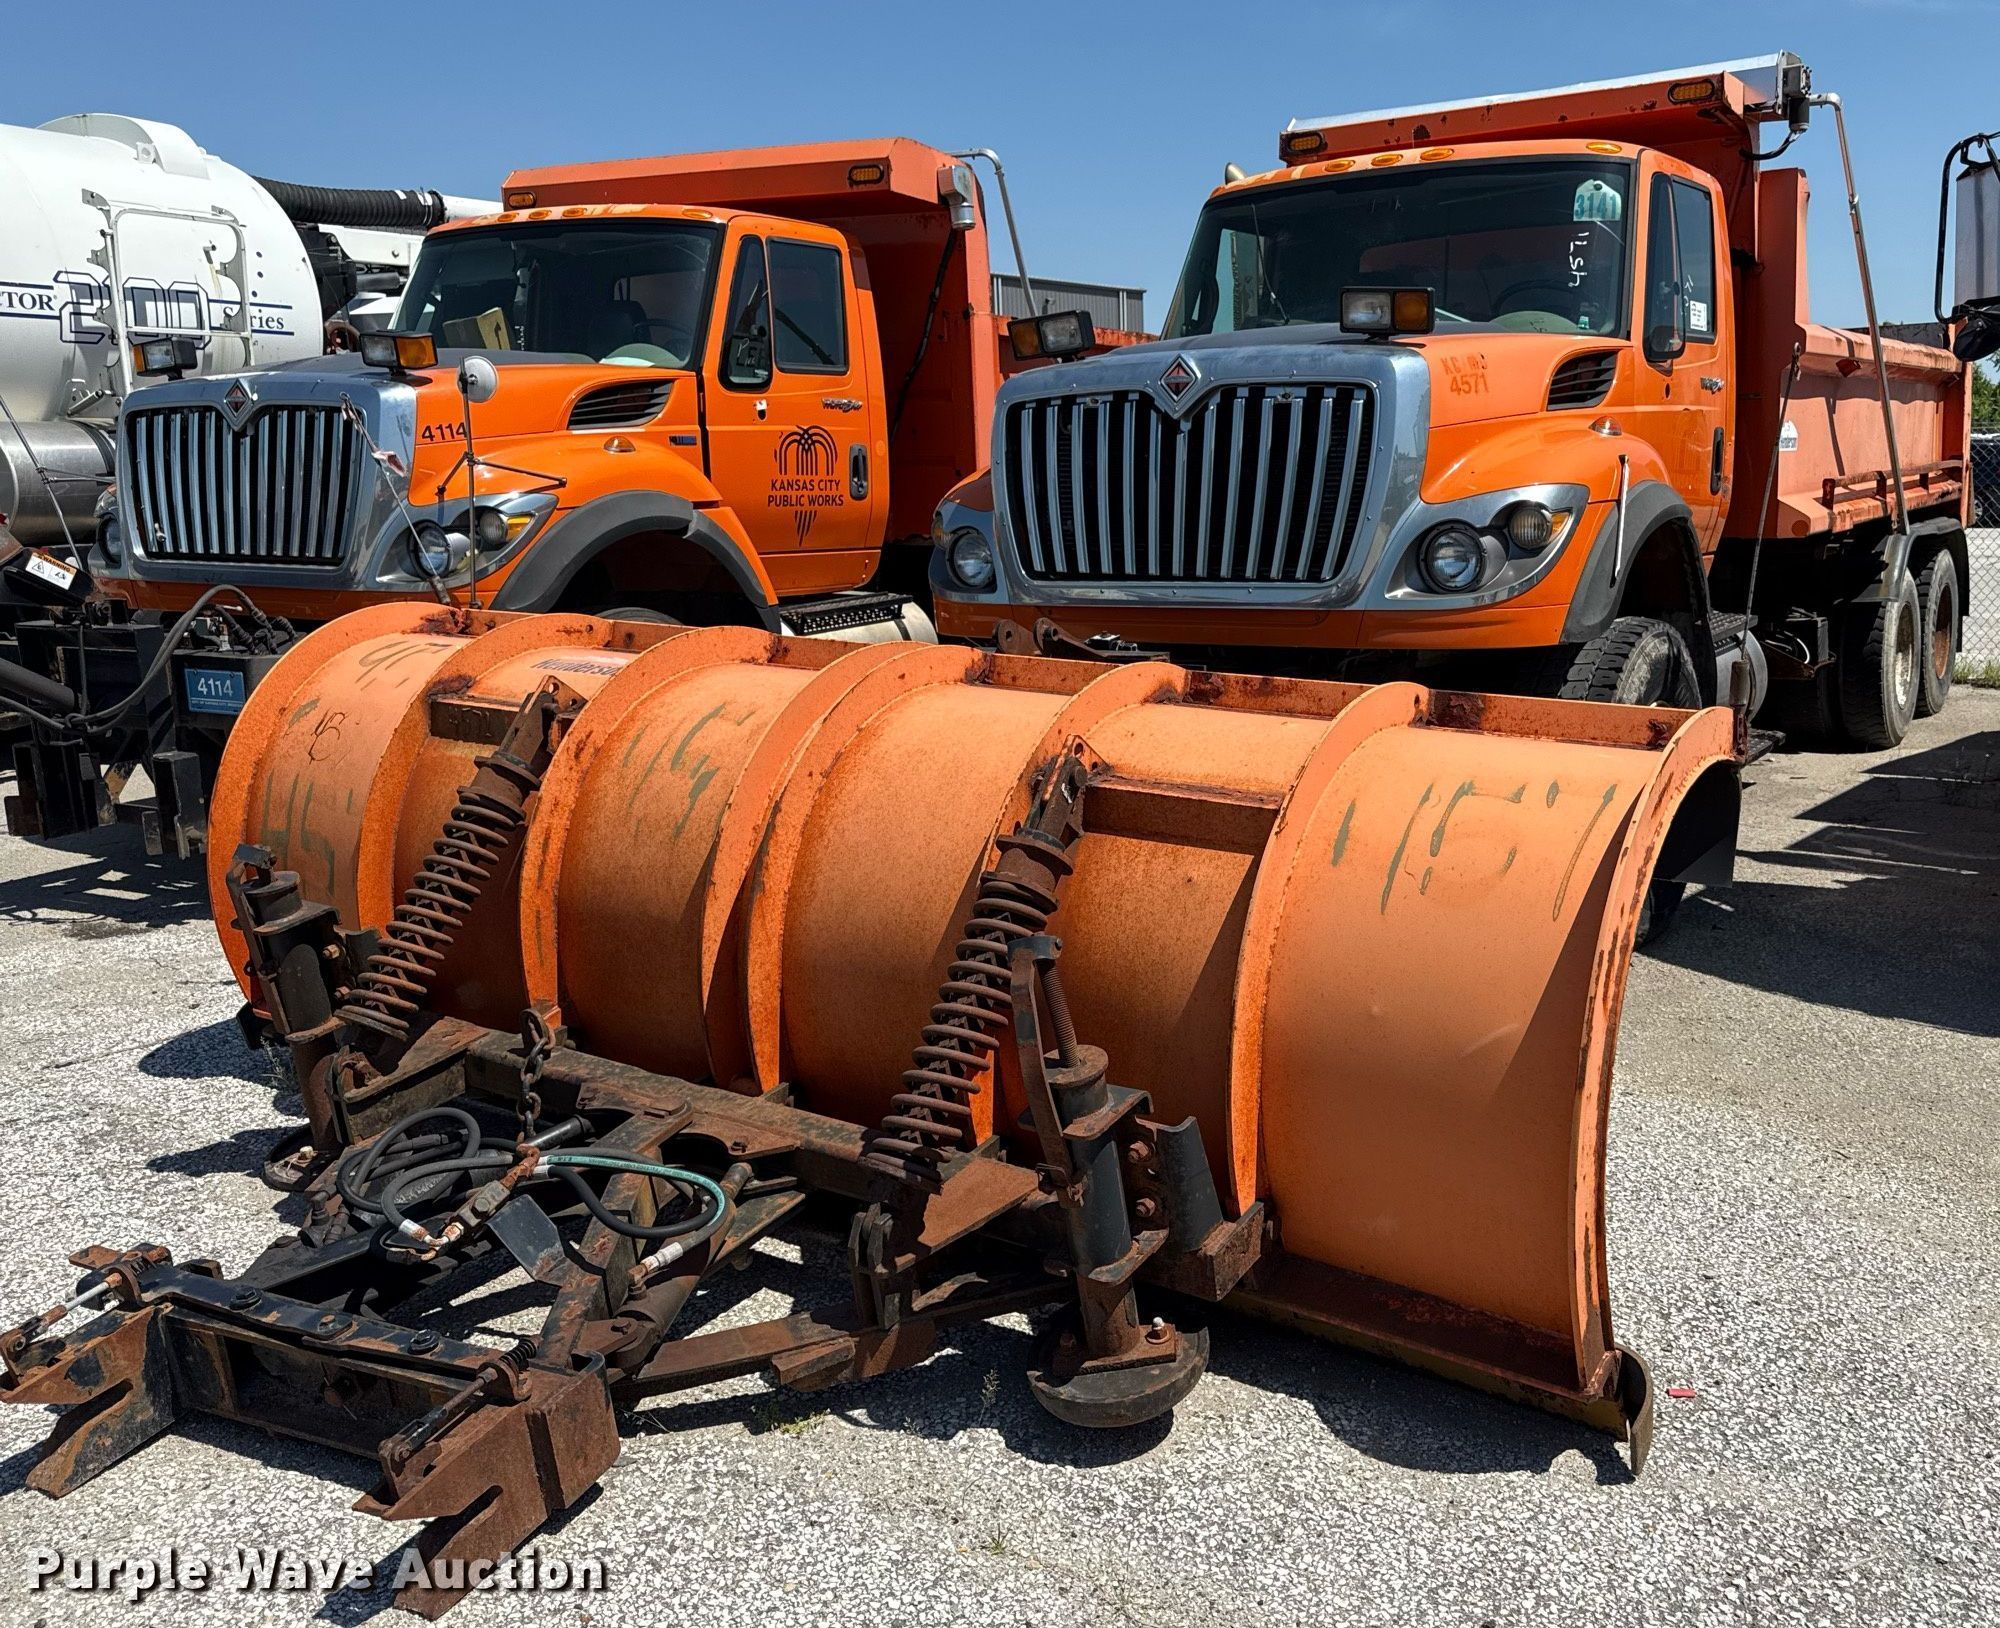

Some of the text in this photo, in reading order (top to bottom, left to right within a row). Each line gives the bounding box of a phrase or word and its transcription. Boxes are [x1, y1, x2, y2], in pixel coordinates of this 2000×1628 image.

[1574, 193, 1618, 220] 3141
[0, 291, 56, 311] TOR
[223, 306, 285, 330] Sries
[1450, 373, 1489, 396] 4571
[421, 422, 467, 441] 4114
[771, 479, 841, 491] KANSAS CITY
[768, 495, 844, 507] PUBLIC WORKS
[197, 677, 233, 697] 4114
